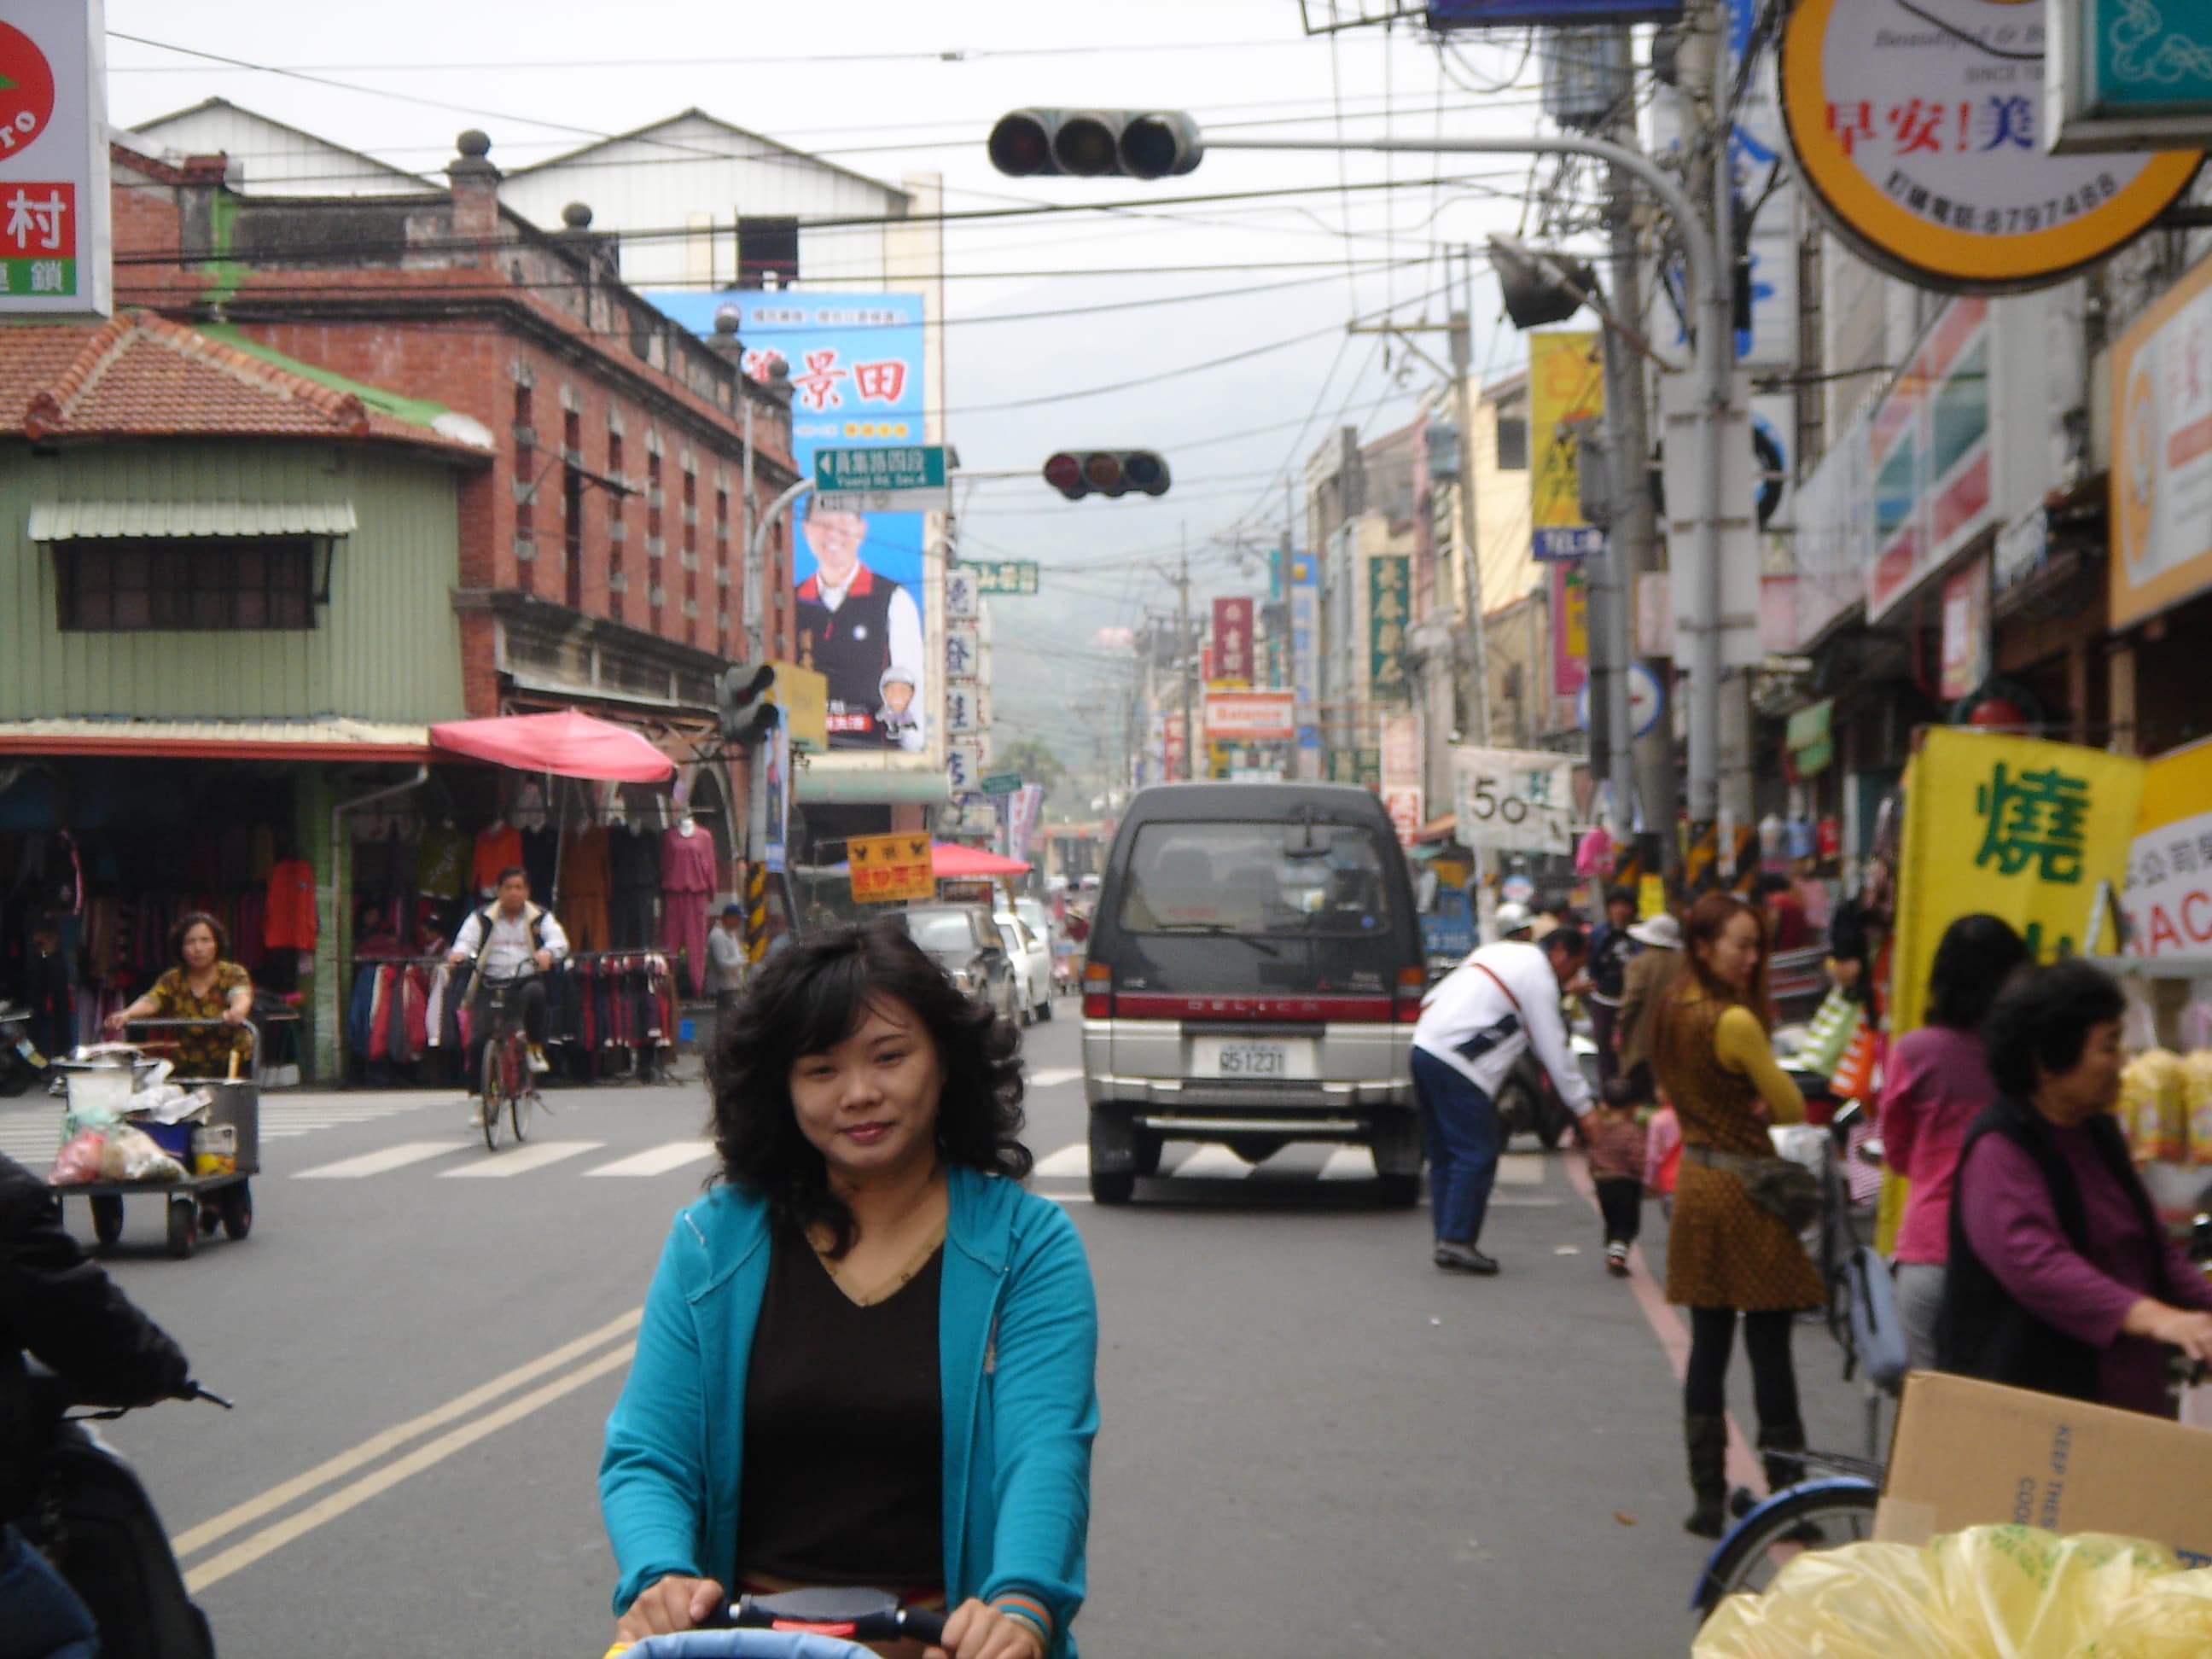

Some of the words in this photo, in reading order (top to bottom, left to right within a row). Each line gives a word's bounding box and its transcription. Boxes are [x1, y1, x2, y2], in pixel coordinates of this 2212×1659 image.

[1825, 95, 2034, 156] 早安!美
[7, 189, 67, 249] 村
